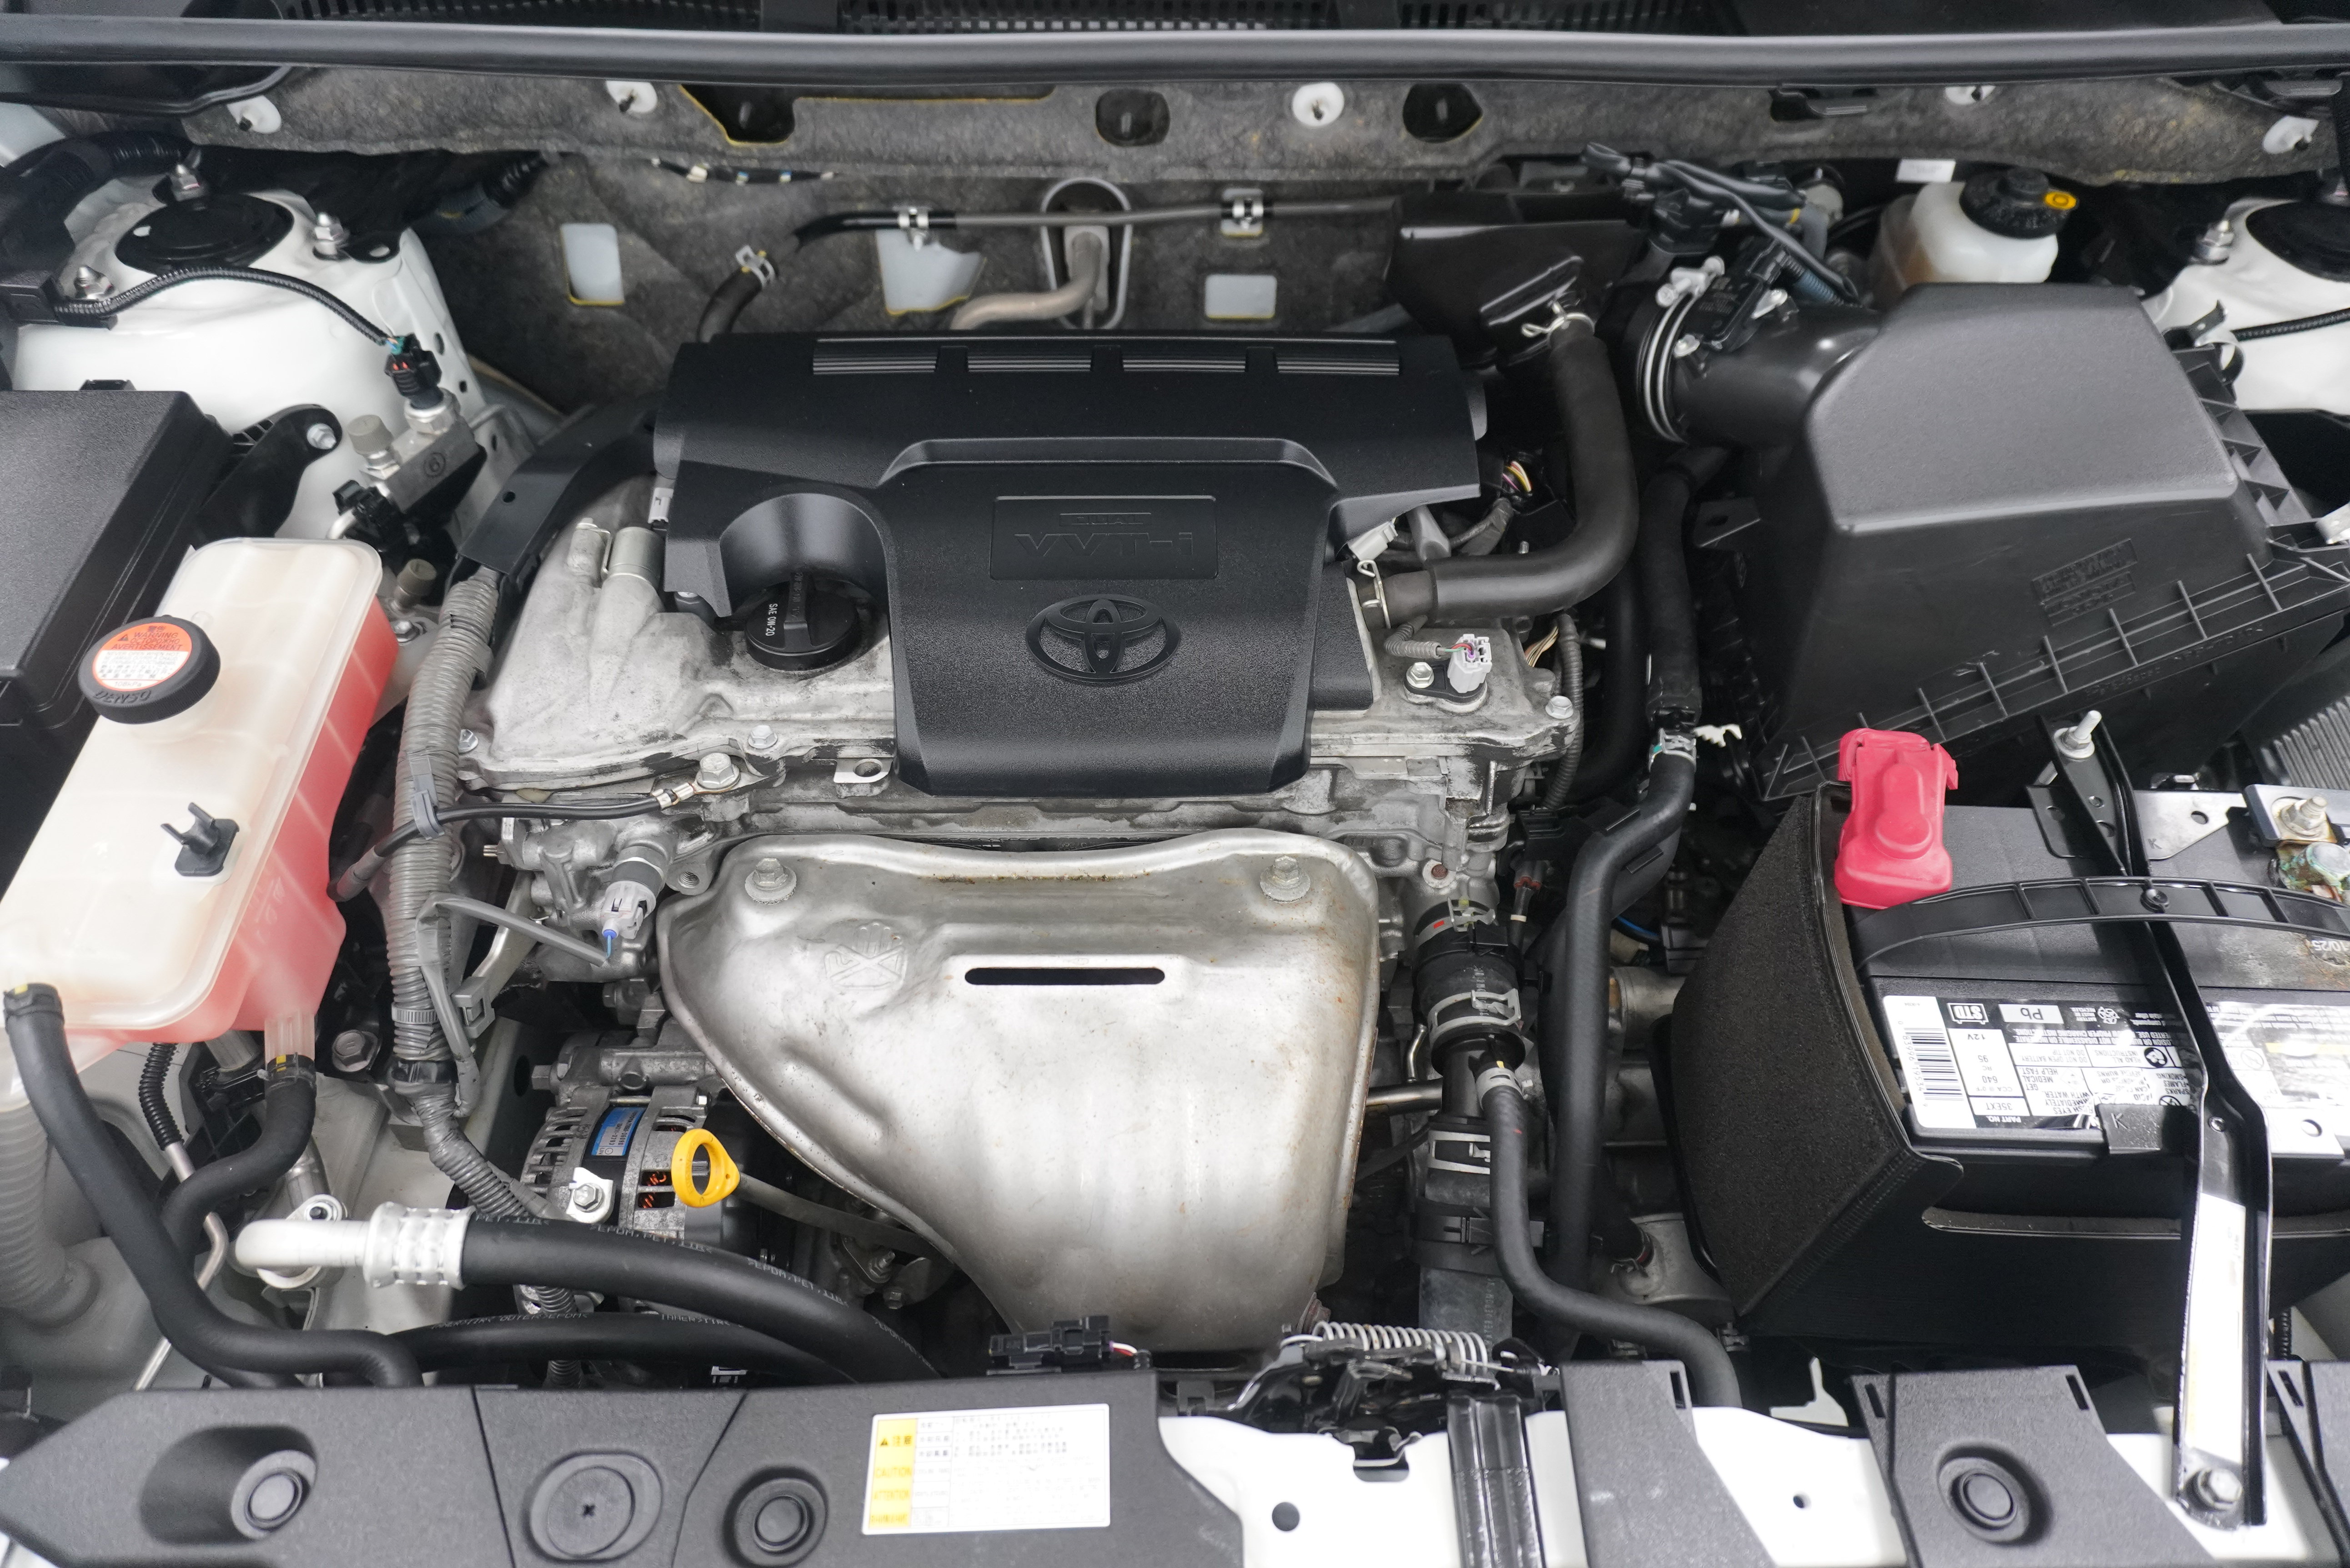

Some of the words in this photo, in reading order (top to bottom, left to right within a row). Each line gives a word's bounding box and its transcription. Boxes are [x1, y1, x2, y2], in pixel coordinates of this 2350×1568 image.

[1072, 515, 1143, 525] DUAL
[1014, 533, 1192, 556] VVT-i
[768, 603, 778, 615] SAE
[765, 616, 777, 636] 0W-20
[94, 689, 152, 704] DENSO
[1953, 1005, 1983, 1019] STD
[2020, 1008, 2043, 1020] Pb
[1903, 1035, 1914, 1061] 83996
[1913, 1067, 1925, 1091] 19534
[1985, 1102, 2013, 1111] 35EXT
[2110, 1113, 2127, 1129] K
[892, 1435, 912, 1447] 注意
[875, 1467, 912, 1478] CAUTION
[874, 1489, 910, 1500] ATTENTION
